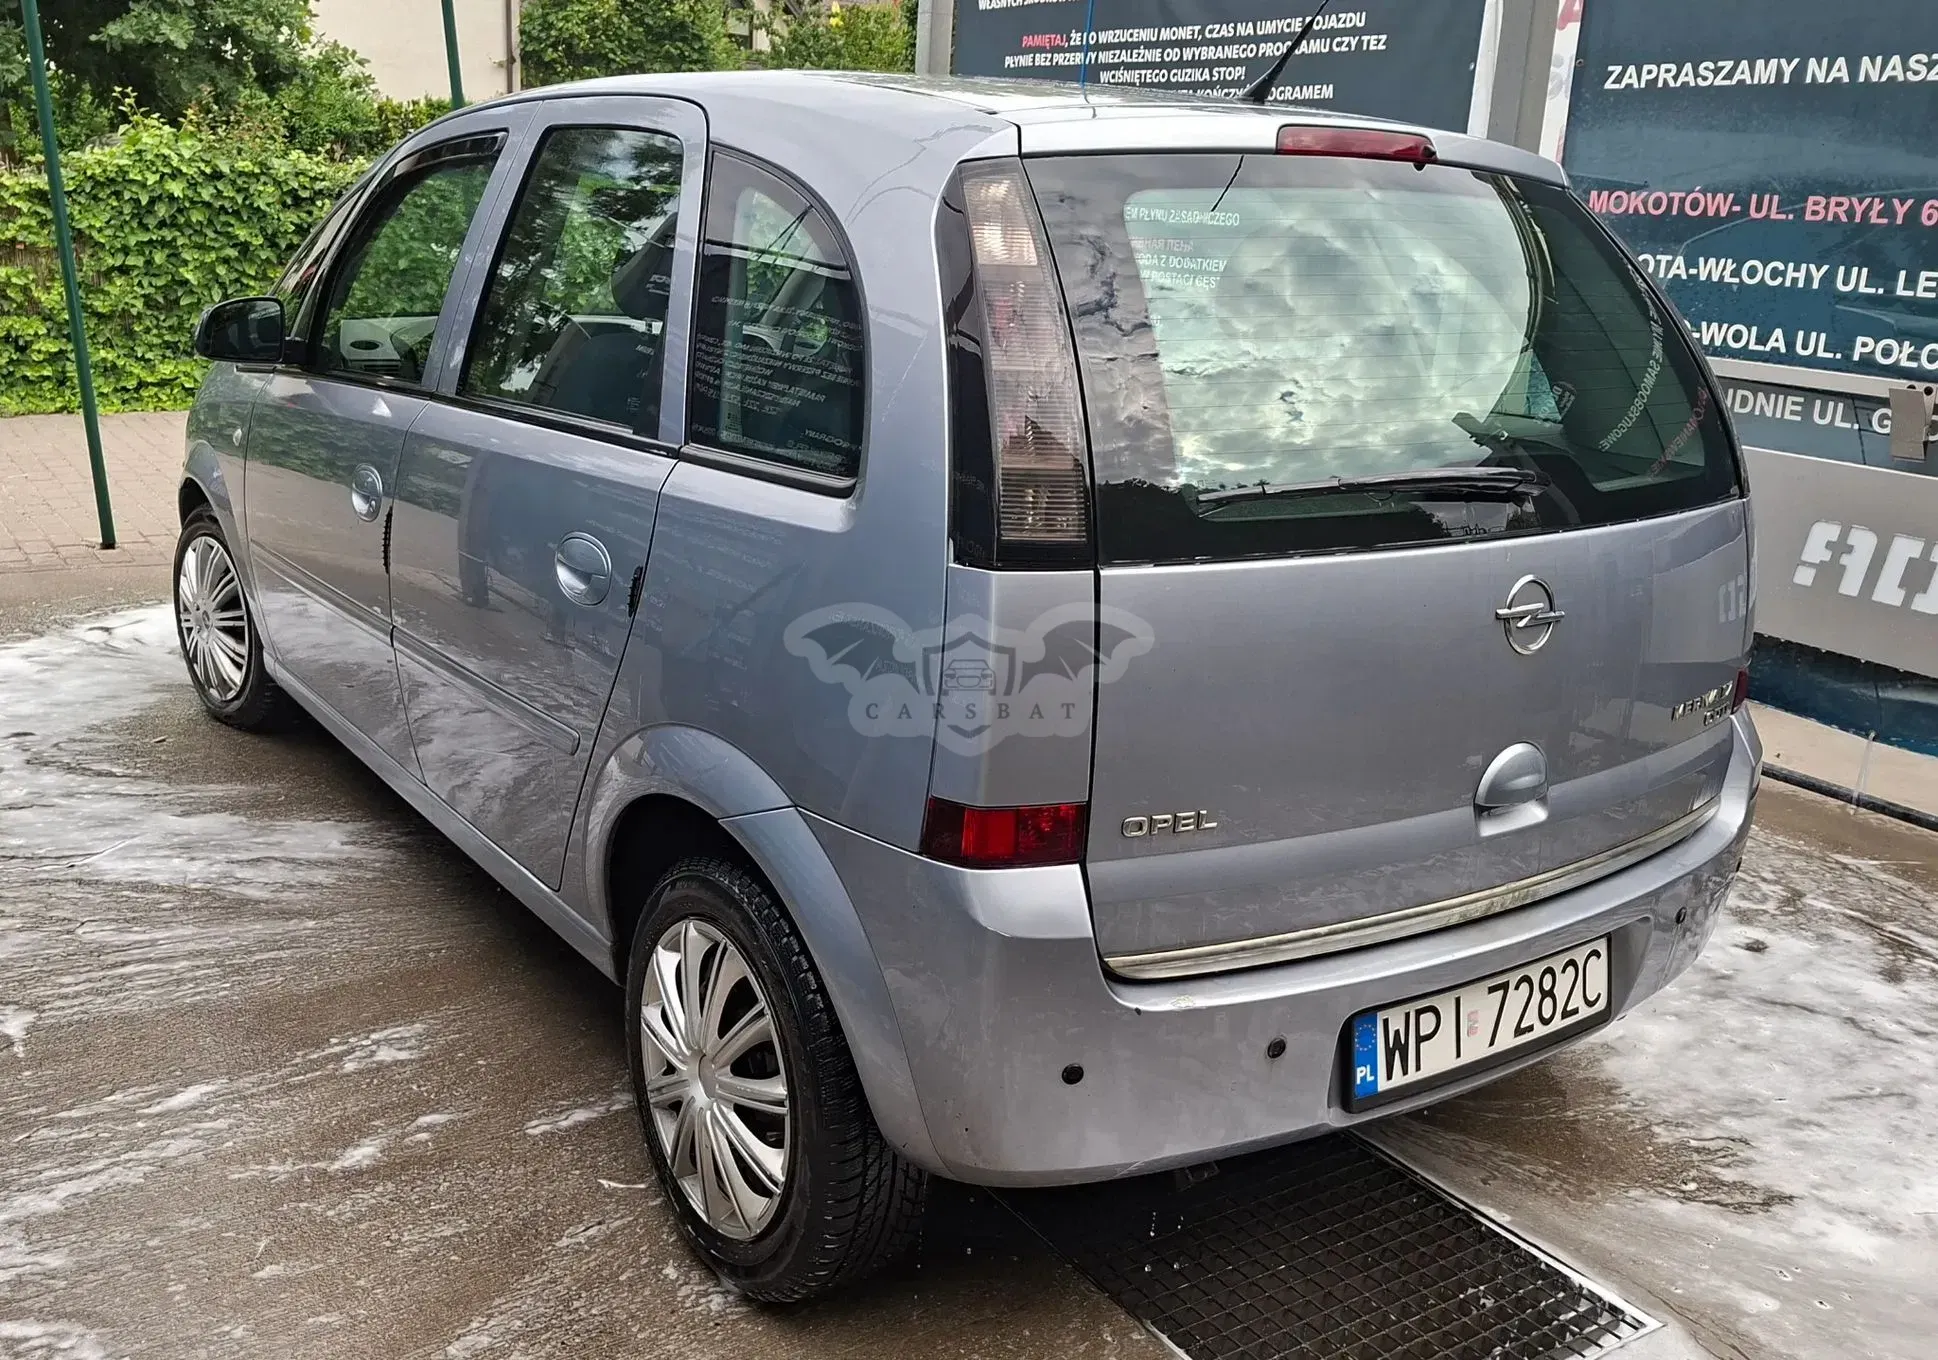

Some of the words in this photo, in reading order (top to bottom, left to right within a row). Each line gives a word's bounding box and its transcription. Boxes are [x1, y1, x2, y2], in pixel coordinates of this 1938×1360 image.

[1070, 29, 1082, 46] ŻE
[1098, 28, 1159, 44] WRZUCENIU
[1159, 25, 1202, 42] MONET,
[1205, 22, 1235, 39] CZAS
[1236, 20, 1254, 36] NA
[1259, 17, 1303, 36] UMYCIE
[1004, 53, 1035, 68] PŁYNIE
[1035, 52, 1051, 66] BEZ
[1098, 45, 1162, 64] NIEZALEŻNIE
[1164, 48, 1181, 62] OD
[1182, 43, 1257, 61] WYBRANEGO
[1332, 36, 1359, 52] CZY
[1099, 66, 1169, 86] WCIŚNIĘTEGO
[1170, 68, 1211, 83] GUZIKA
[1212, 66, 1246, 81] STOP!
[1603, 58, 1800, 90] ZAPRASZAMY
[1805, 56, 1850, 84] NA
[1750, 193, 1795, 221] UL.
[1804, 195, 1915, 226] BRYŁY
[1836, 265, 1884, 295] UL.
[1895, 269, 1938, 299] LE
[1685, 319, 1787, 354] -WOLA
[1795, 329, 1842, 360] UL.
[1812, 399, 1860, 431] UL.
[1121, 808, 1218, 838] OPEL
[1382, 996, 1462, 1082] WPI
[1487, 948, 1603, 1048] 7282C
[1356, 1066, 1375, 1085] PL
